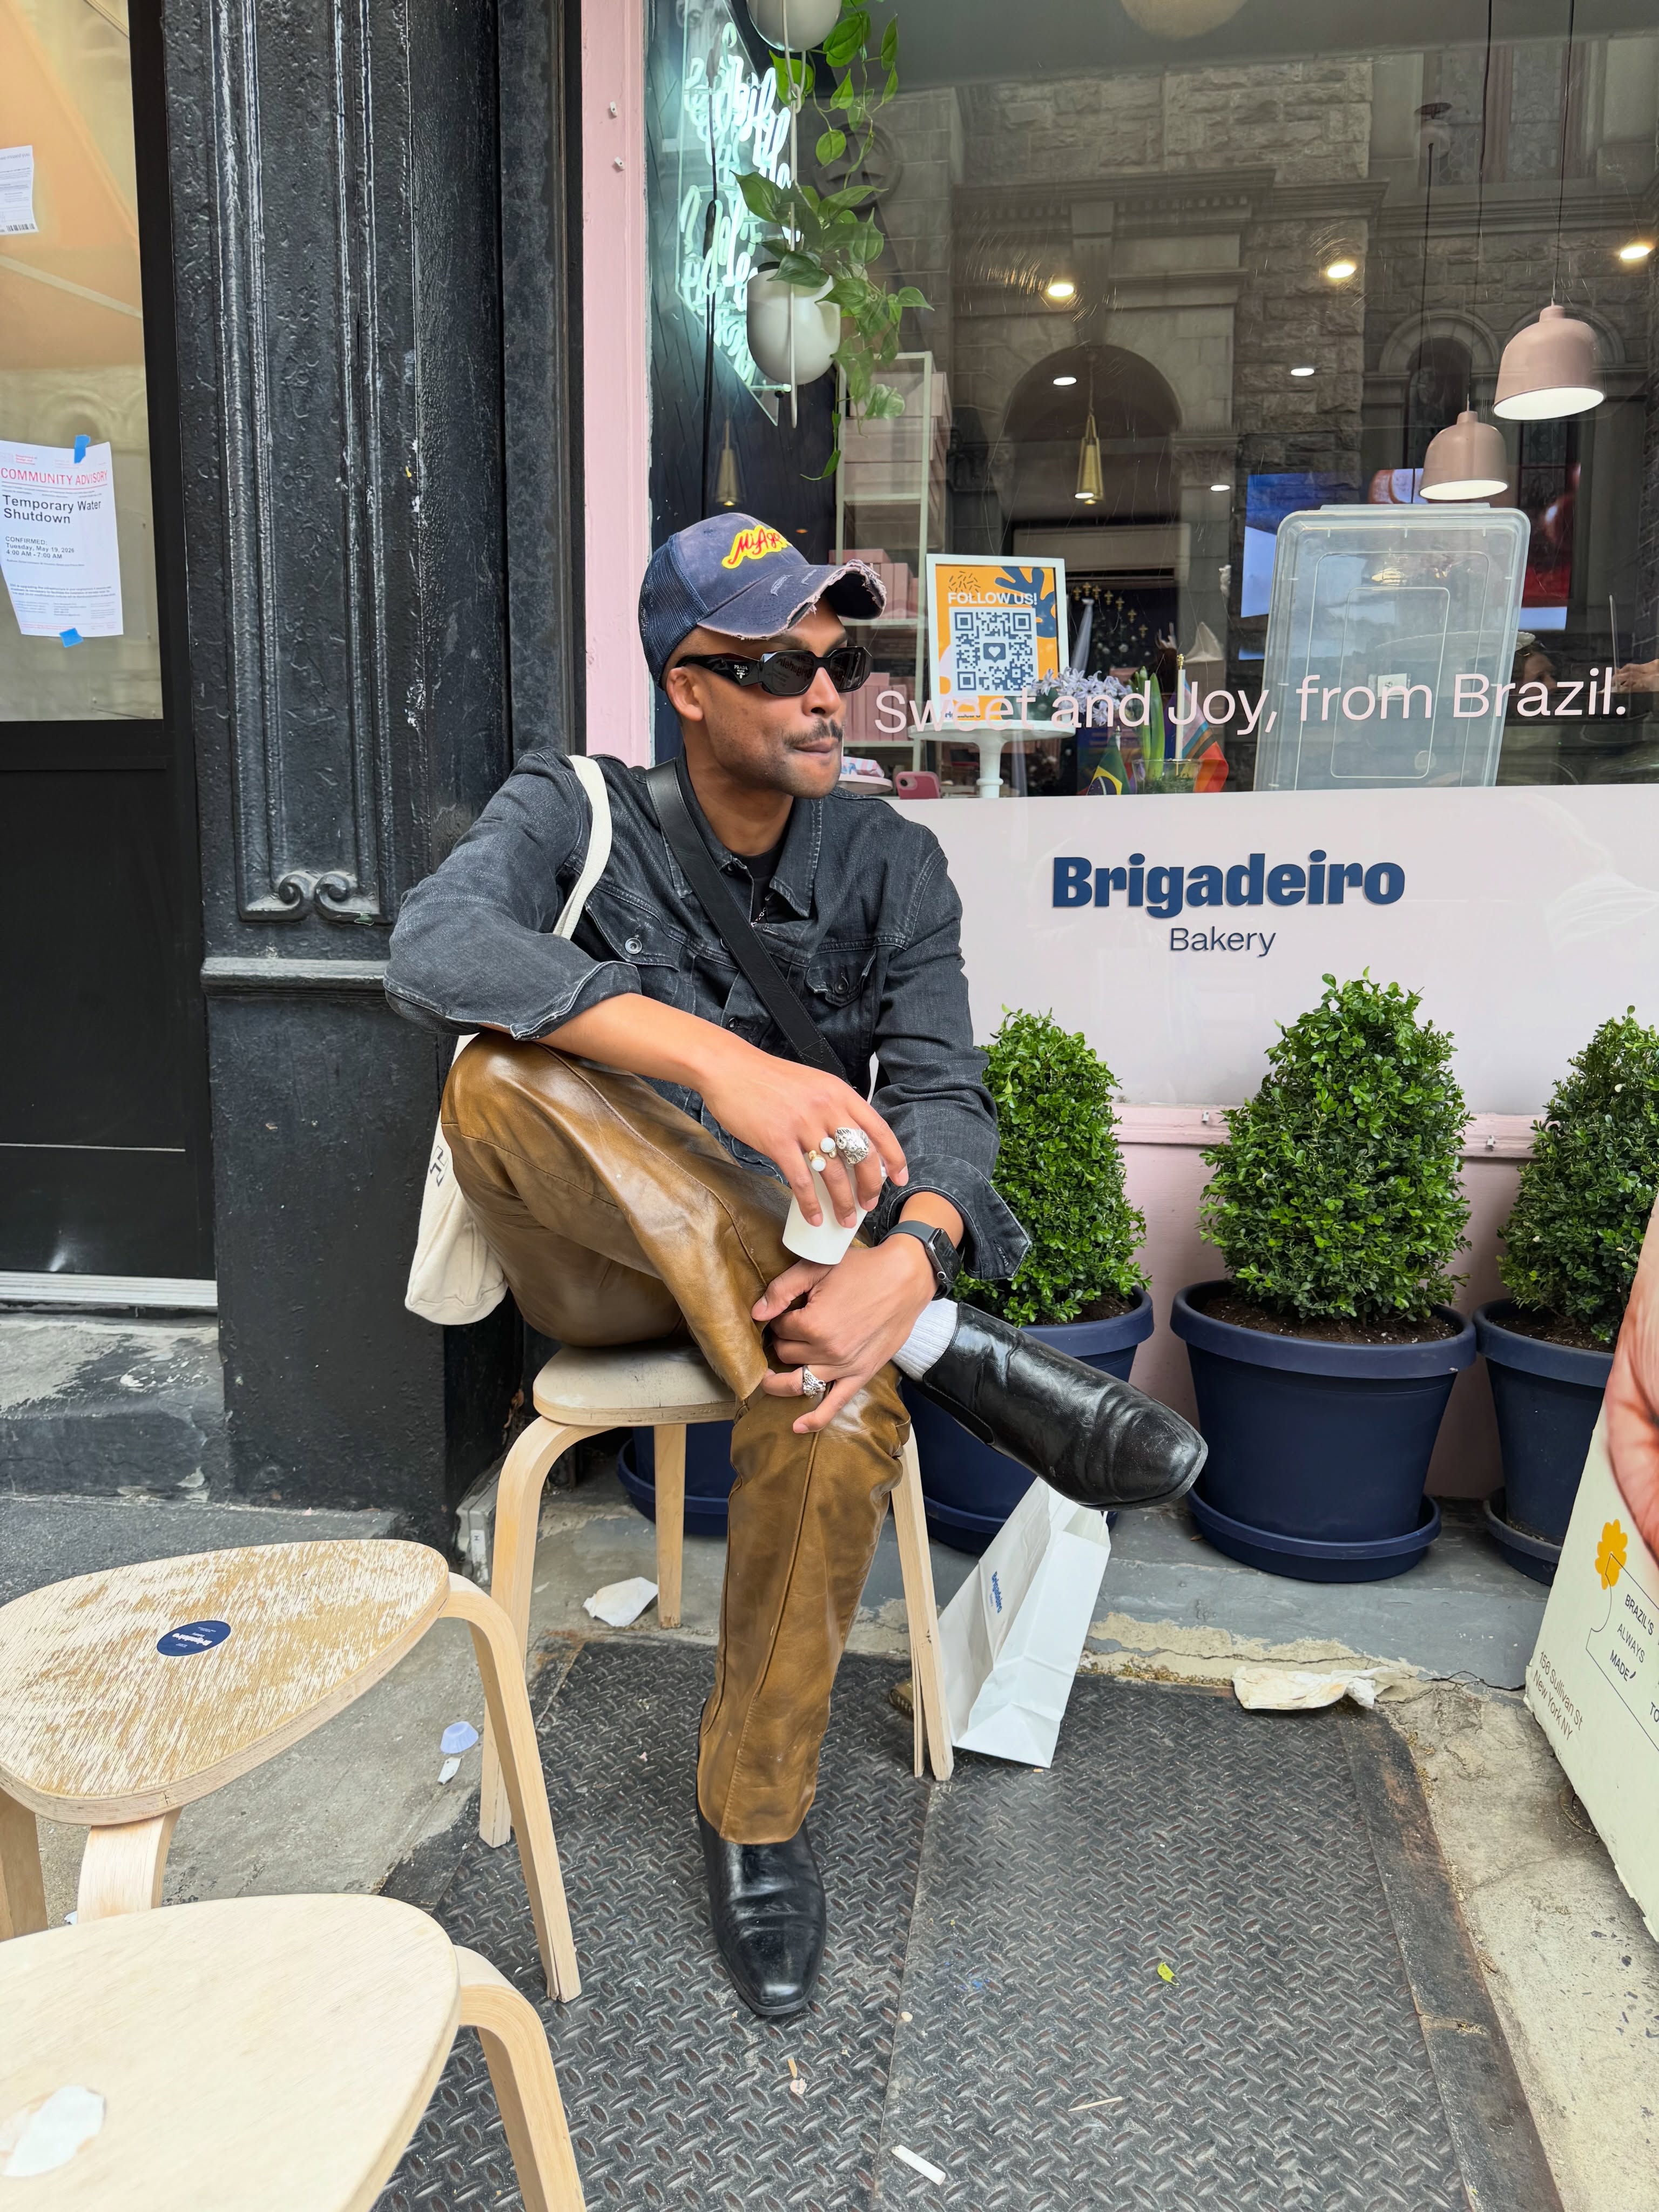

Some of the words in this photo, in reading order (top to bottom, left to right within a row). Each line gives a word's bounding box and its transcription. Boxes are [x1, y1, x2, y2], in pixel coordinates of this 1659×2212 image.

[1, 468, 72, 485] COMMUNITY
[75, 470, 108, 485] ADVISORY
[2, 494, 74, 514] Temporary
[77, 501, 102, 511] Water
[4, 508, 70, 524] Shutdown
[5, 536, 48, 545] CONFIRMED:
[5, 543, 35, 551] Tuesday,
[948, 592, 1010, 604] FOLLOW
[1014, 592, 1037, 605] US!
[875, 690, 1036, 733] Sweet
[1051, 680, 1150, 728] and
[1168, 681, 1277, 735] Joy,
[1296, 675, 1432, 721] from
[1453, 667, 1627, 718] Brazil.
[1052, 849, 1405, 919] Brigadeiro
[1170, 926, 1276, 957] Bakery
[1625, 1594, 1654, 1636] BRAZIL'S
[1617, 1623, 1645, 1663] ALWAYS
[1533, 1669, 1548, 1700] New
[1548, 1692, 1562, 1725] York
[1561, 1717, 1573, 1740] NY
[1539, 1651, 1551, 1675] 156
[1550, 1669, 1574, 1716] Sullivan
[1574, 1709, 1583, 1731] St
